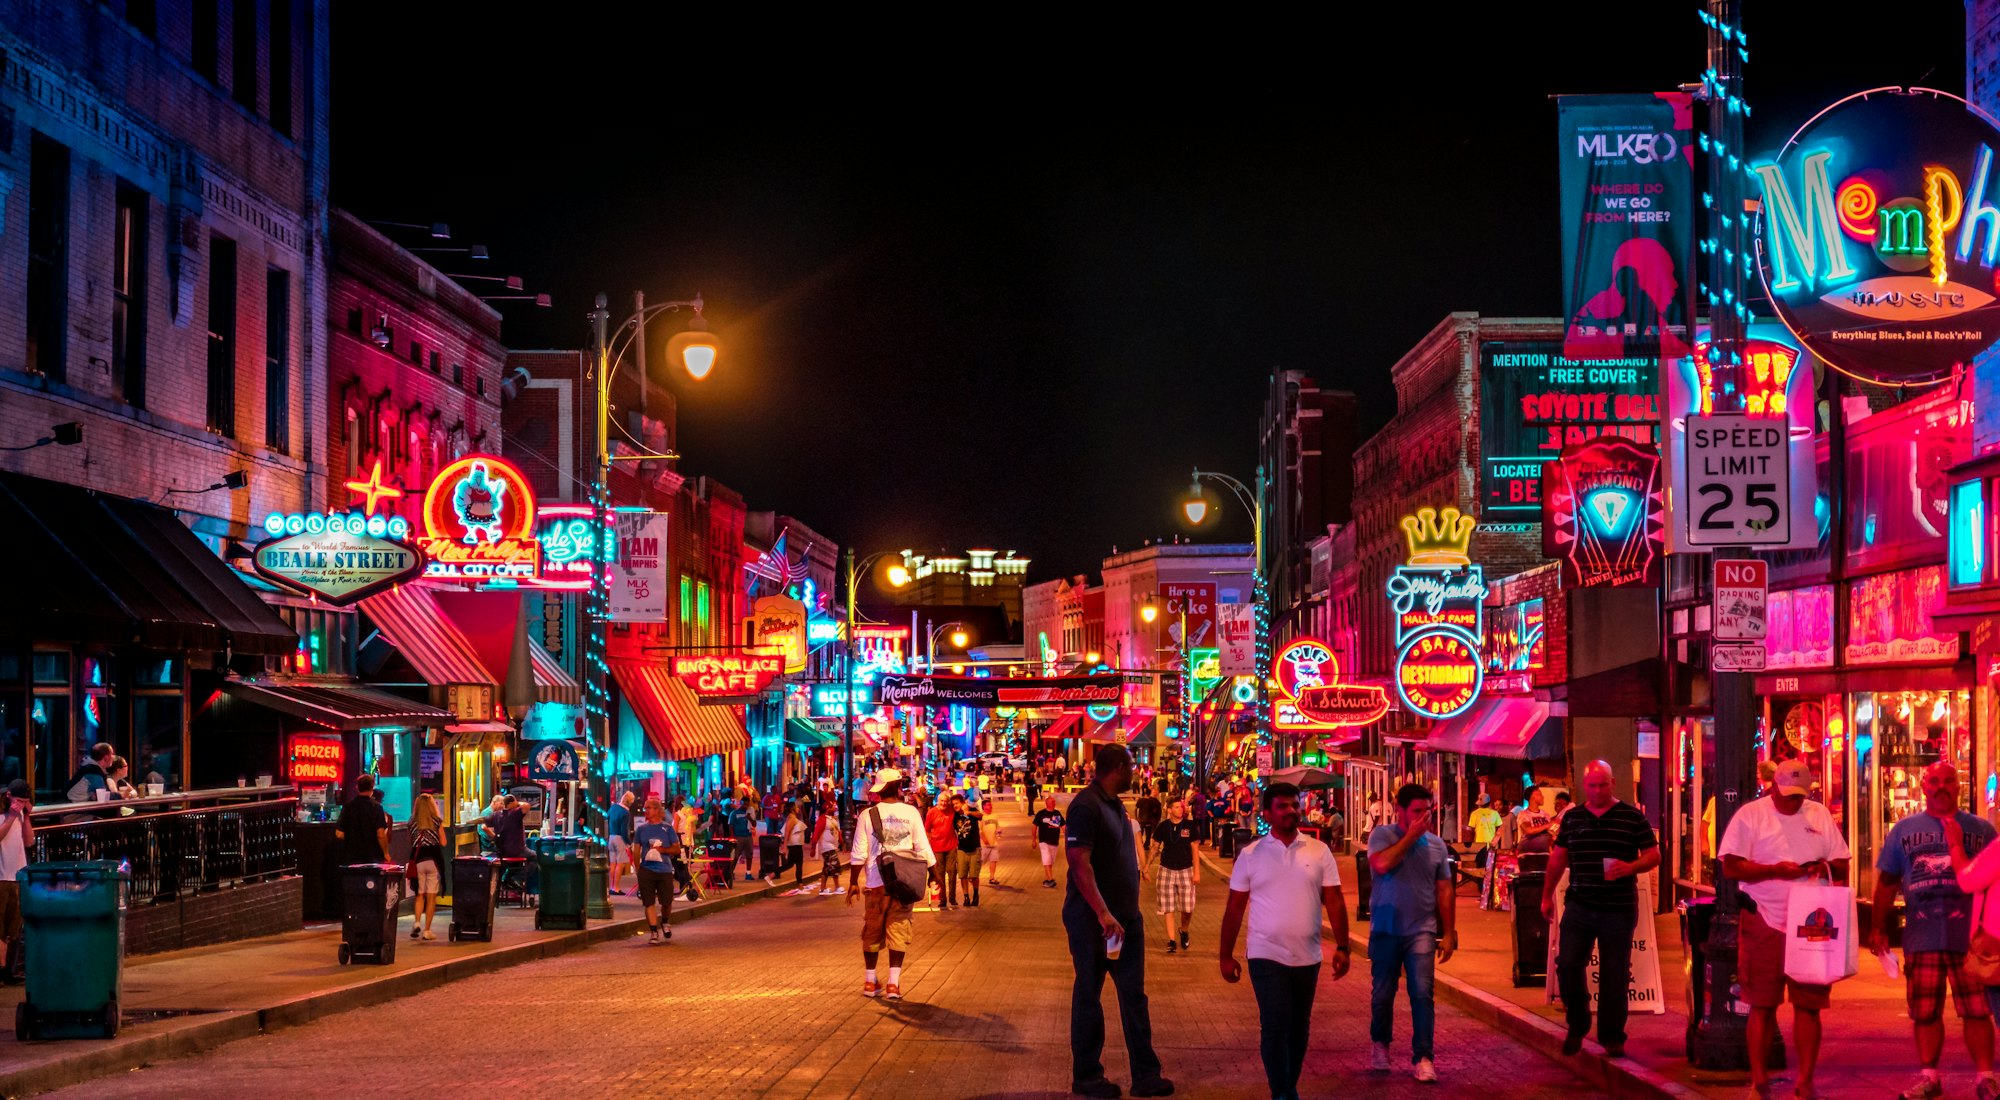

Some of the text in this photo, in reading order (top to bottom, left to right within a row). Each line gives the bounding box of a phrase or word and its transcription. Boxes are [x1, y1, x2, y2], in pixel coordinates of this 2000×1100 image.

[1591, 183, 1664, 195] WHERE DO
[1605, 197, 1651, 208] WE GO
[1584, 211, 1671, 223] FROM HERE?
[1832, 331, 1877, 340] Everything
[1879, 331, 1904, 340] Blues,
[1906, 331, 1924, 340] Soul
[1926, 331, 1933, 340] &
[1493, 354, 1548, 367] MENTION
[1550, 369, 1637, 383] FREE COVER
[1521, 393, 1608, 420] COYOTE
[1695, 428, 1780, 448] SPEED
[1704, 456, 1770, 475] LIMIT
[1698, 483, 1780, 530] 25
[312, 541, 337, 550] World
[339, 541, 369, 551] Famous
[631, 537, 658, 555] AM
[265, 551, 407, 569] BEALE STREET
[621, 559, 658, 569] MEMPHIS
[463, 564, 494, 576] CITY
[495, 564, 534, 576] CAFE
[1725, 566, 1756, 583] NO
[627, 580, 648, 588] MLK
[1611, 571, 1642, 587] BEALE
[634, 588, 649, 599] 50
[1168, 586, 1207, 596] Have a
[1719, 590, 1760, 601] PARKING
[1404, 614, 1476, 624] HALL OF FAME
[1748, 621, 1760, 631] TN
[1421, 636, 1458, 654] BAR
[1938, 640, 1957, 654] STUFF
[1284, 645, 1330, 664] PIG
[677, 658, 779, 673] KING'S PALACE
[699, 674, 756, 690] CAFE
[1401, 665, 1476, 685] RESTAURANT
[1776, 678, 1798, 691] ENTER
[881, 680, 1119, 705] Memphis WELCOMES AutoZone
[1319, 690, 1384, 708] Schwab
[1408, 688, 1472, 713] 159 BEALE
[294, 744, 340, 759] FROZEN
[294, 764, 338, 779] DRINKS
